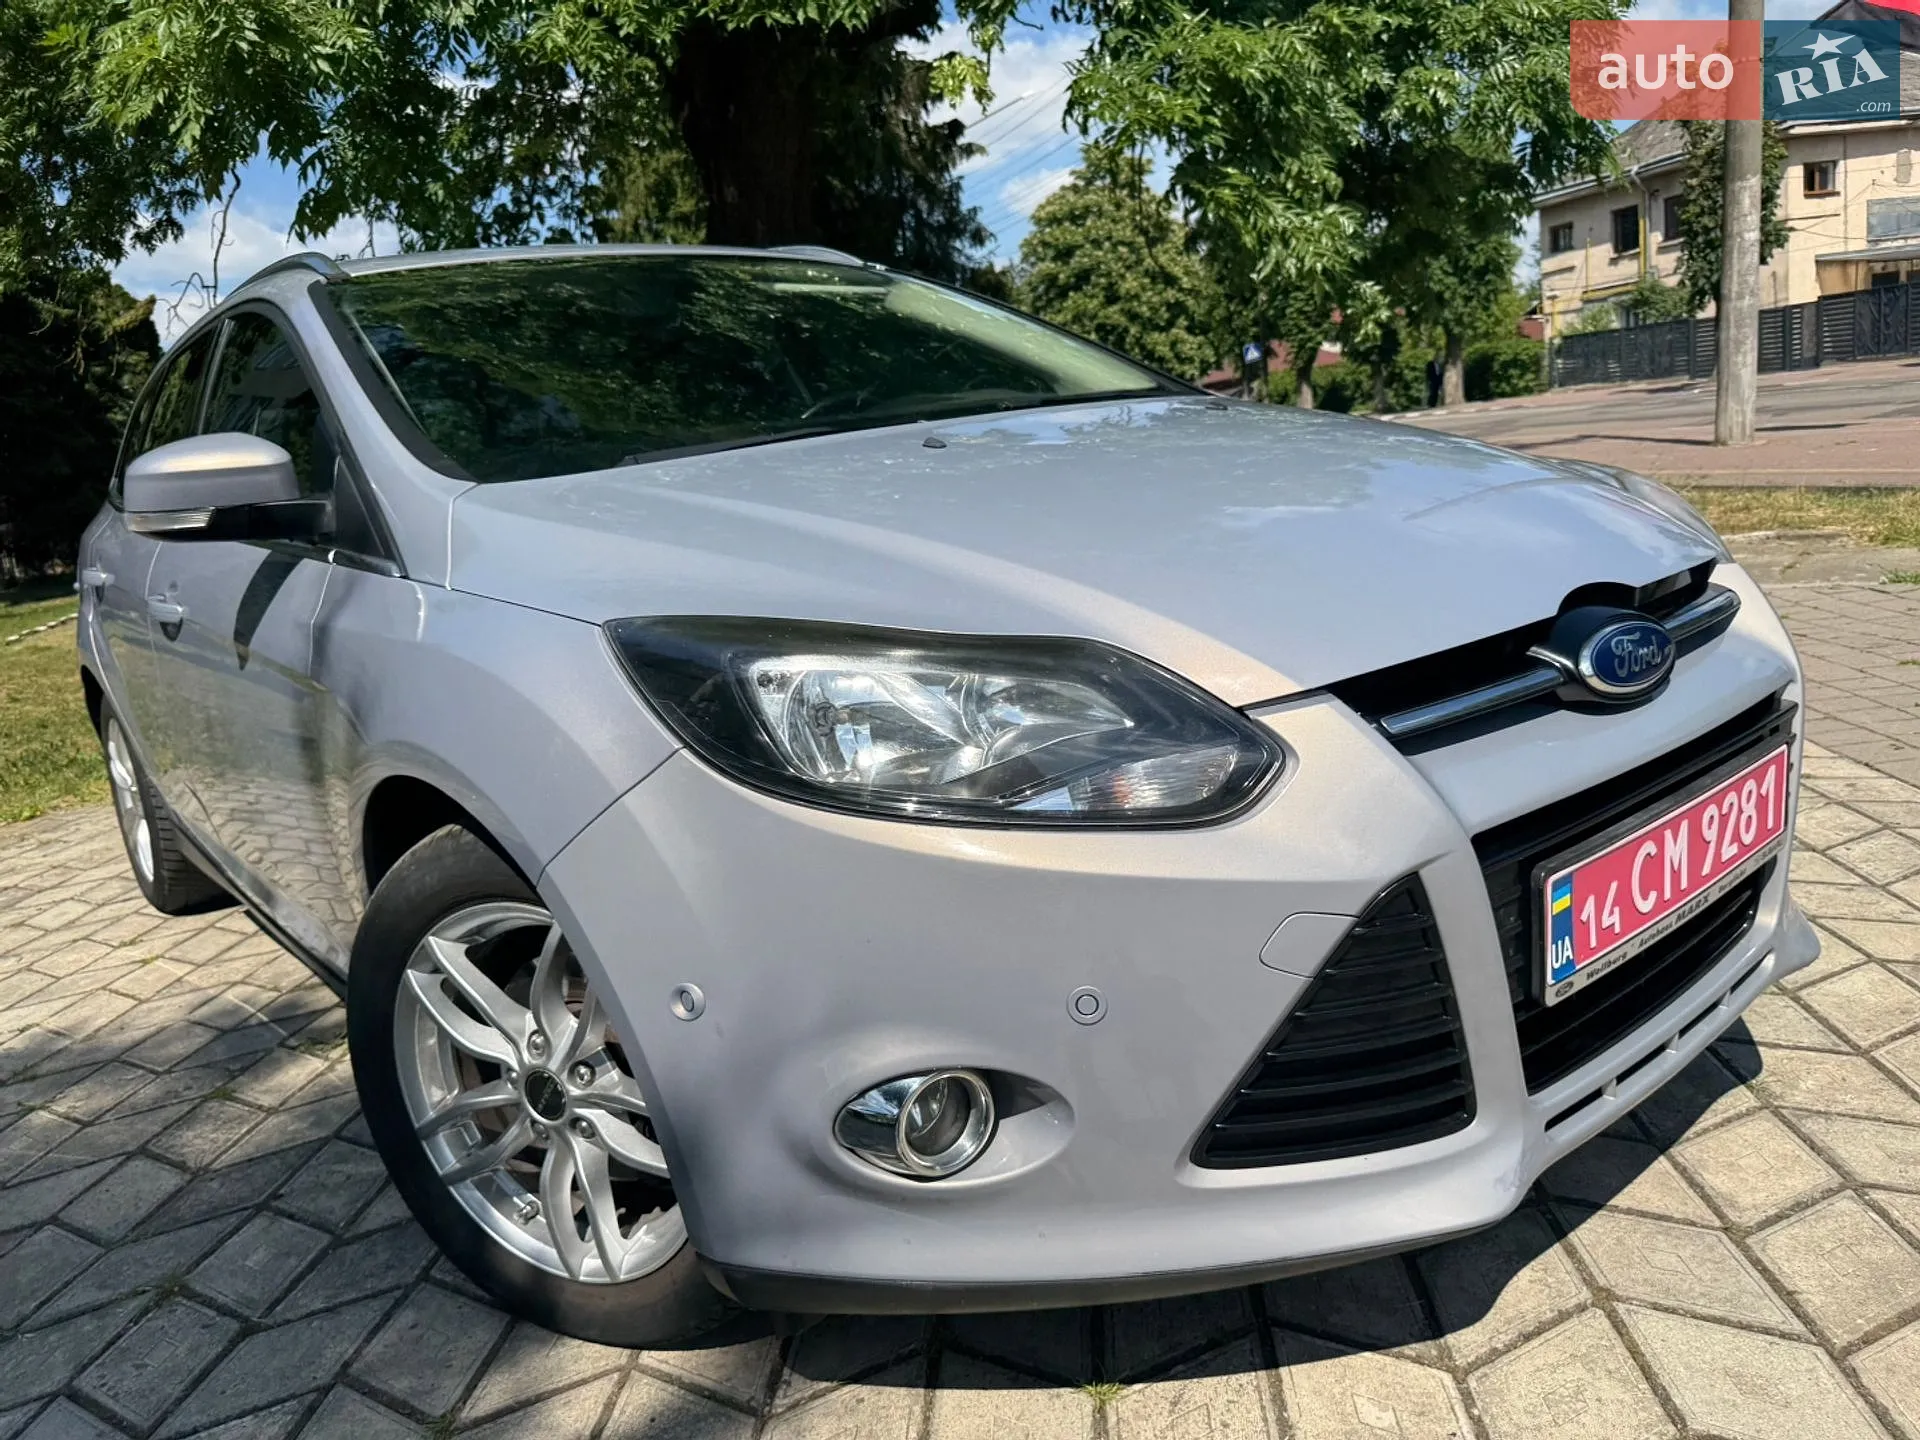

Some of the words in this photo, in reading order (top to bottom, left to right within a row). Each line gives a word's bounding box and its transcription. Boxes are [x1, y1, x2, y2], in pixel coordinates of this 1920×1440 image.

[1610, 632, 1662, 678] Ford
[1579, 880, 1621, 949] 14
[1631, 818, 1688, 914] CM
[1701, 764, 1777, 876] 9281
[1551, 935, 1574, 970] UA
